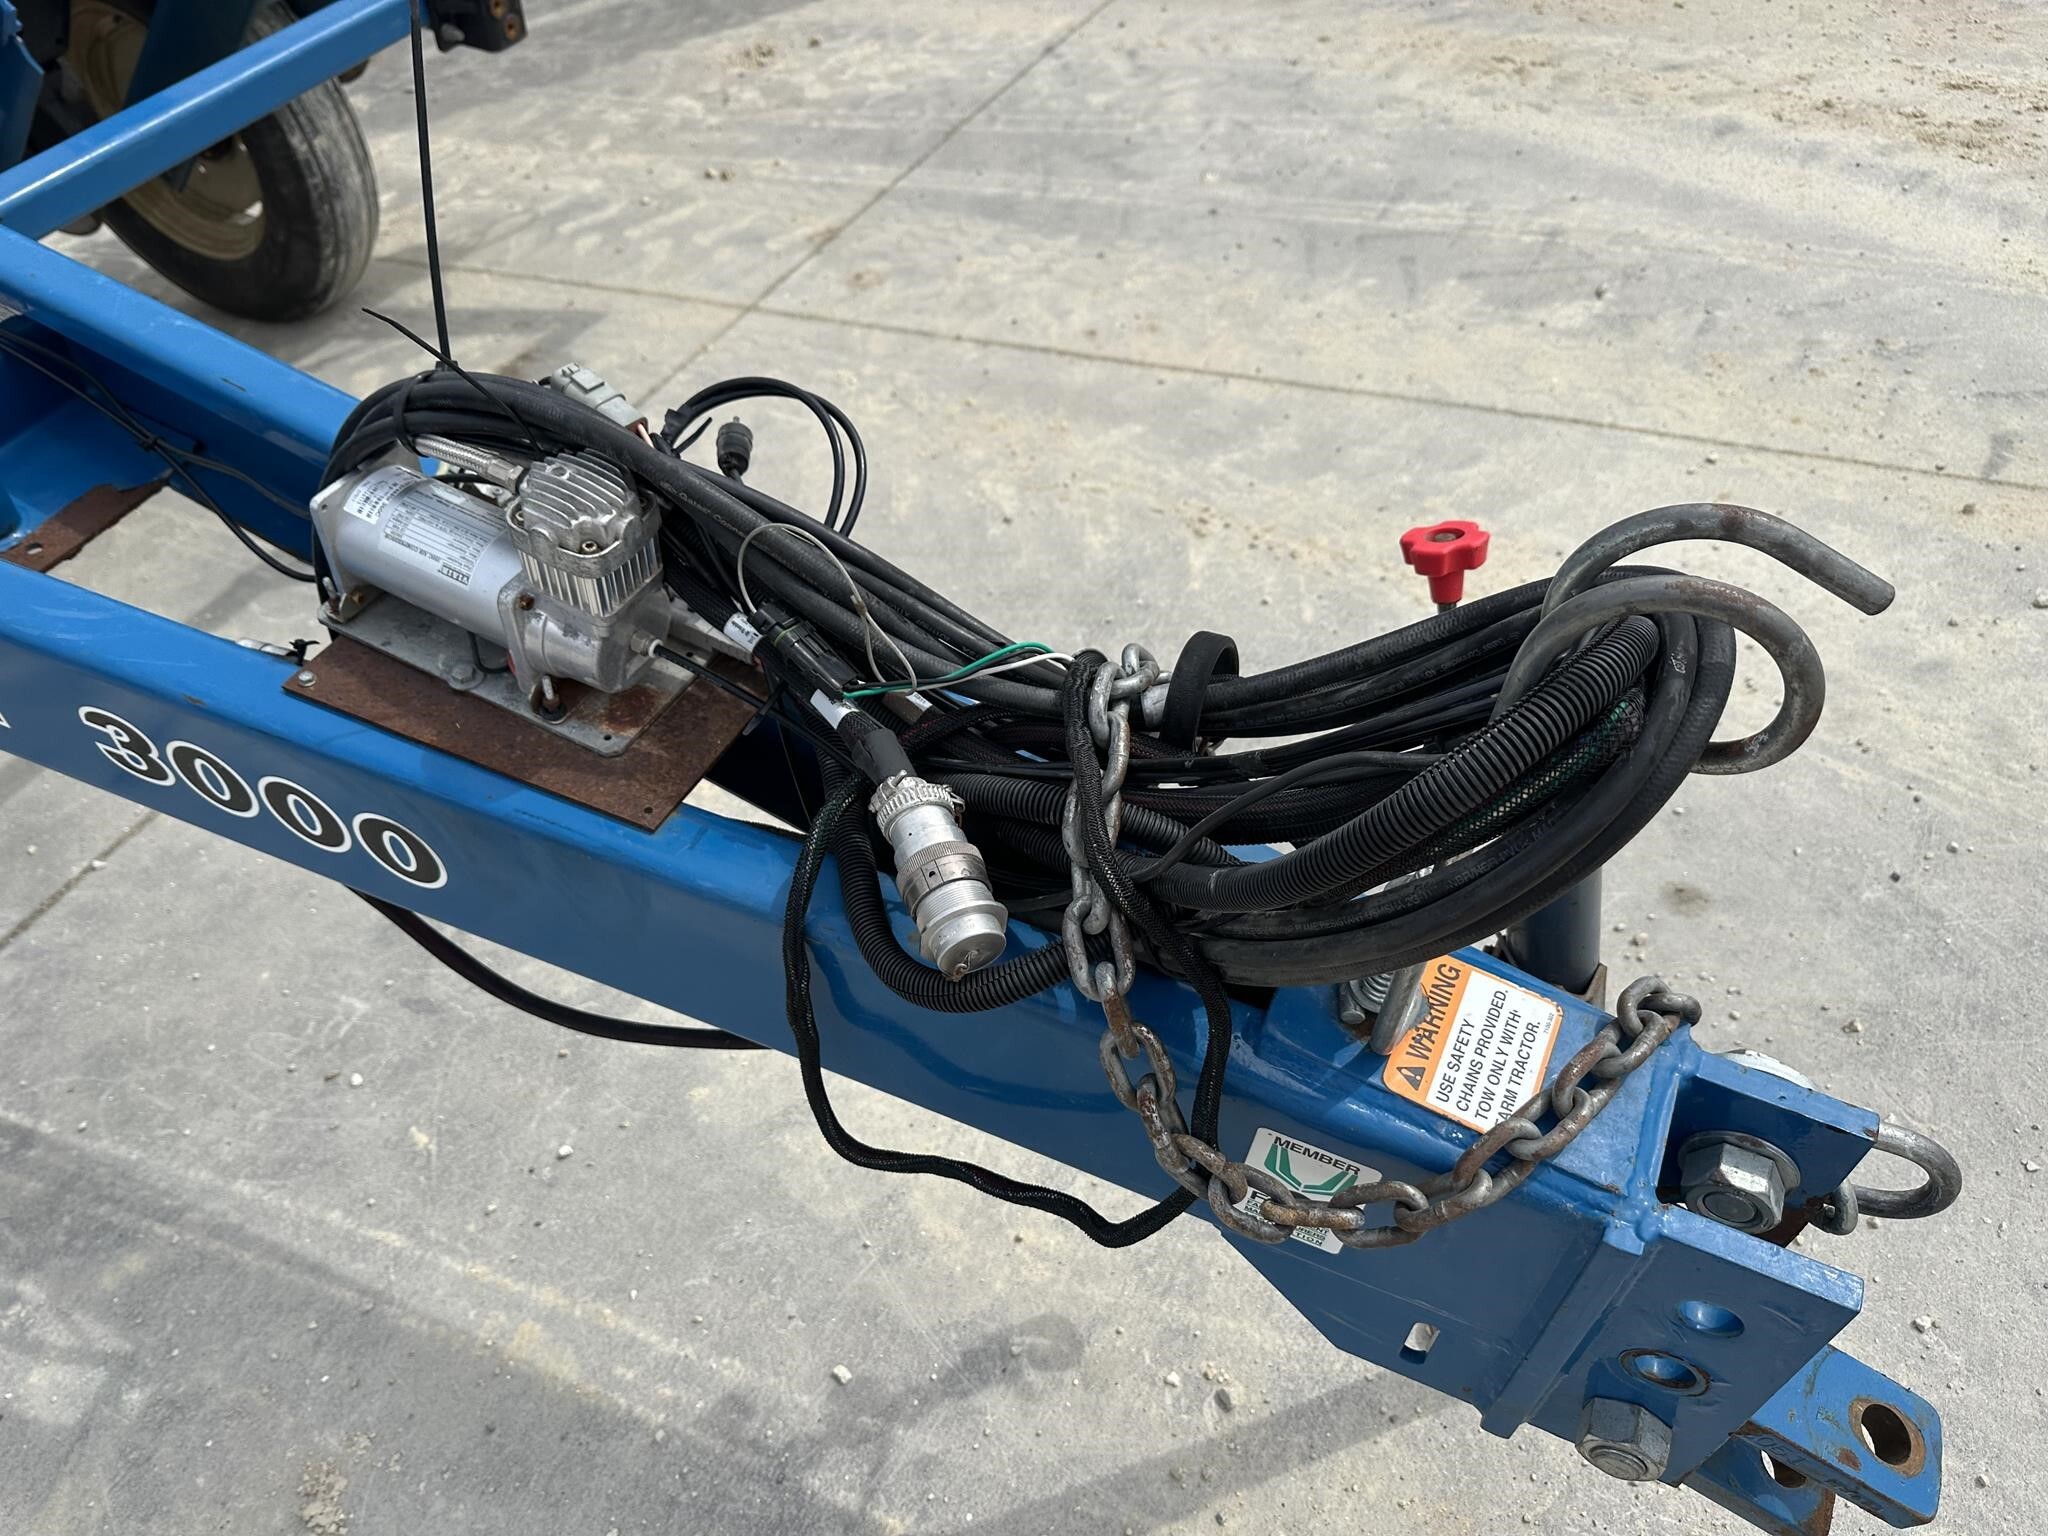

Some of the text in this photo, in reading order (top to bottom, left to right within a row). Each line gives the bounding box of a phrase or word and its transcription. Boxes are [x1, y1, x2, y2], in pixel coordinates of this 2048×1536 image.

[78, 705, 448, 889] 3000
[1406, 963, 1461, 1060] WARNING
[1436, 1018, 1475, 1103] USE SAFETY
[1456, 990, 1509, 1112] CHAINS PROVIDED.
[1475, 1010, 1521, 1121] TOW ONLY WITH
[1495, 1021, 1541, 1125] ARM TRACTOR.
[1273, 1136, 1361, 1176] MEMBER
